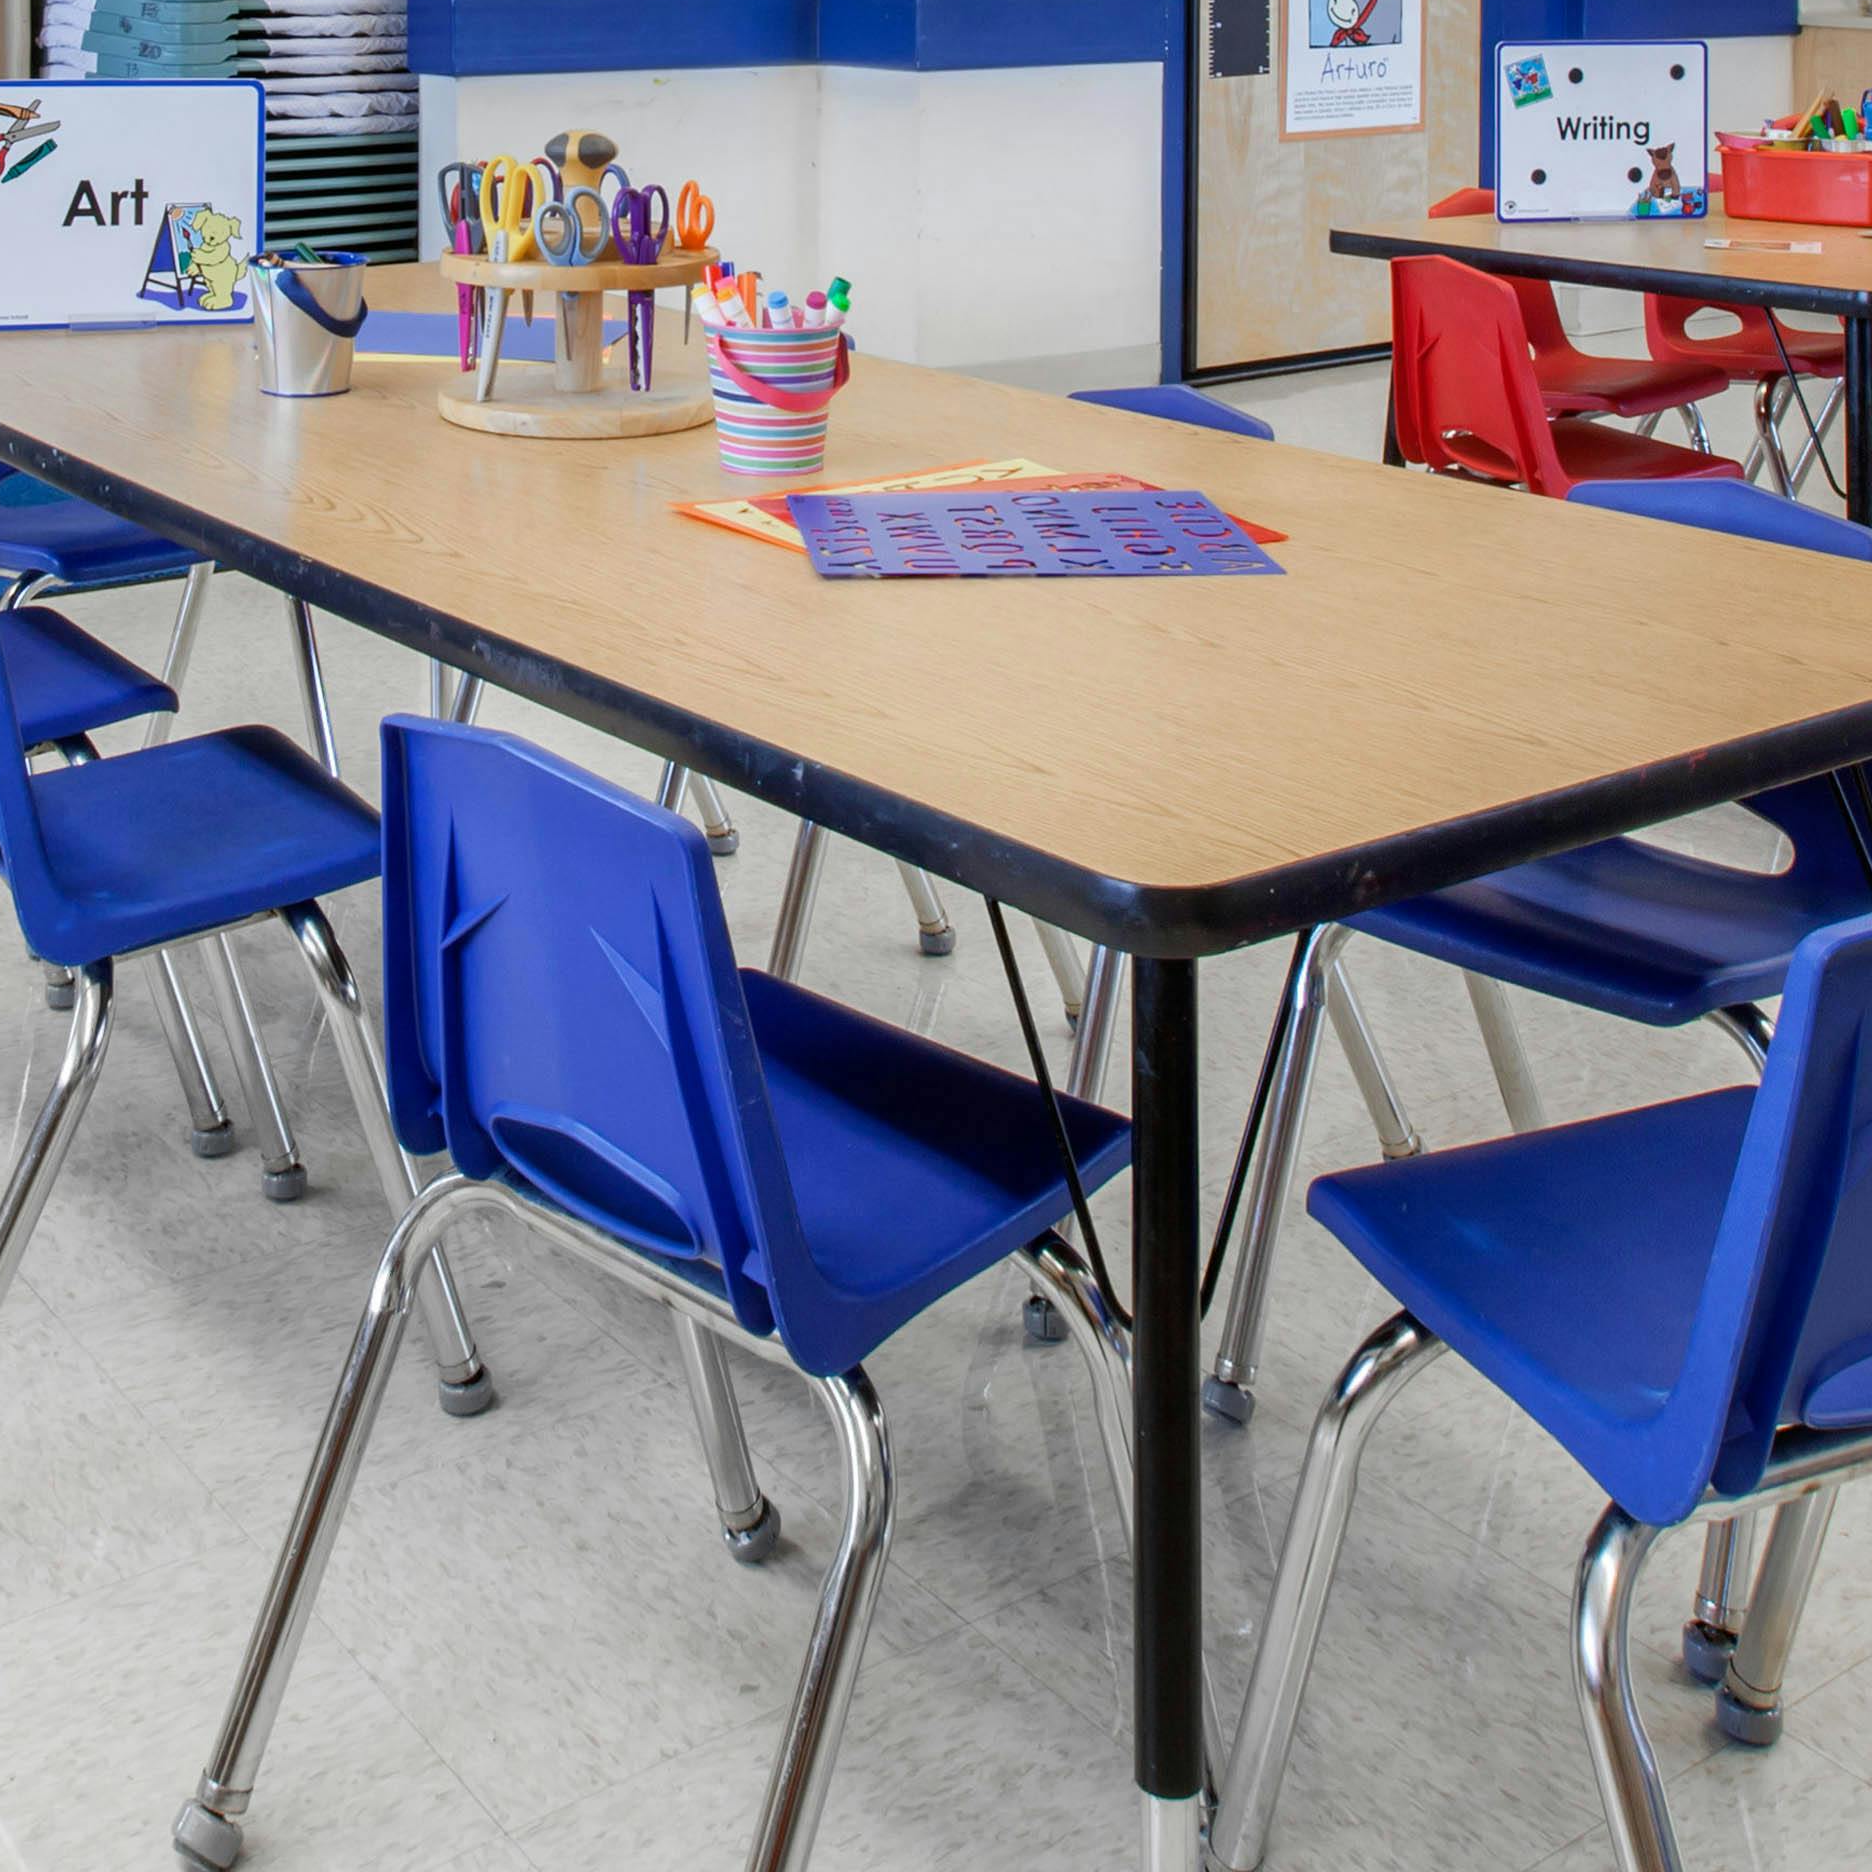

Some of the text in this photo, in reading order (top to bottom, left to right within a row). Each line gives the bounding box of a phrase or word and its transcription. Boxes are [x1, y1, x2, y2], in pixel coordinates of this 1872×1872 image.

[1320, 53, 1388, 82] Arturo
[1557, 115, 1650, 146] Writing
[62, 178, 149, 227] Art
